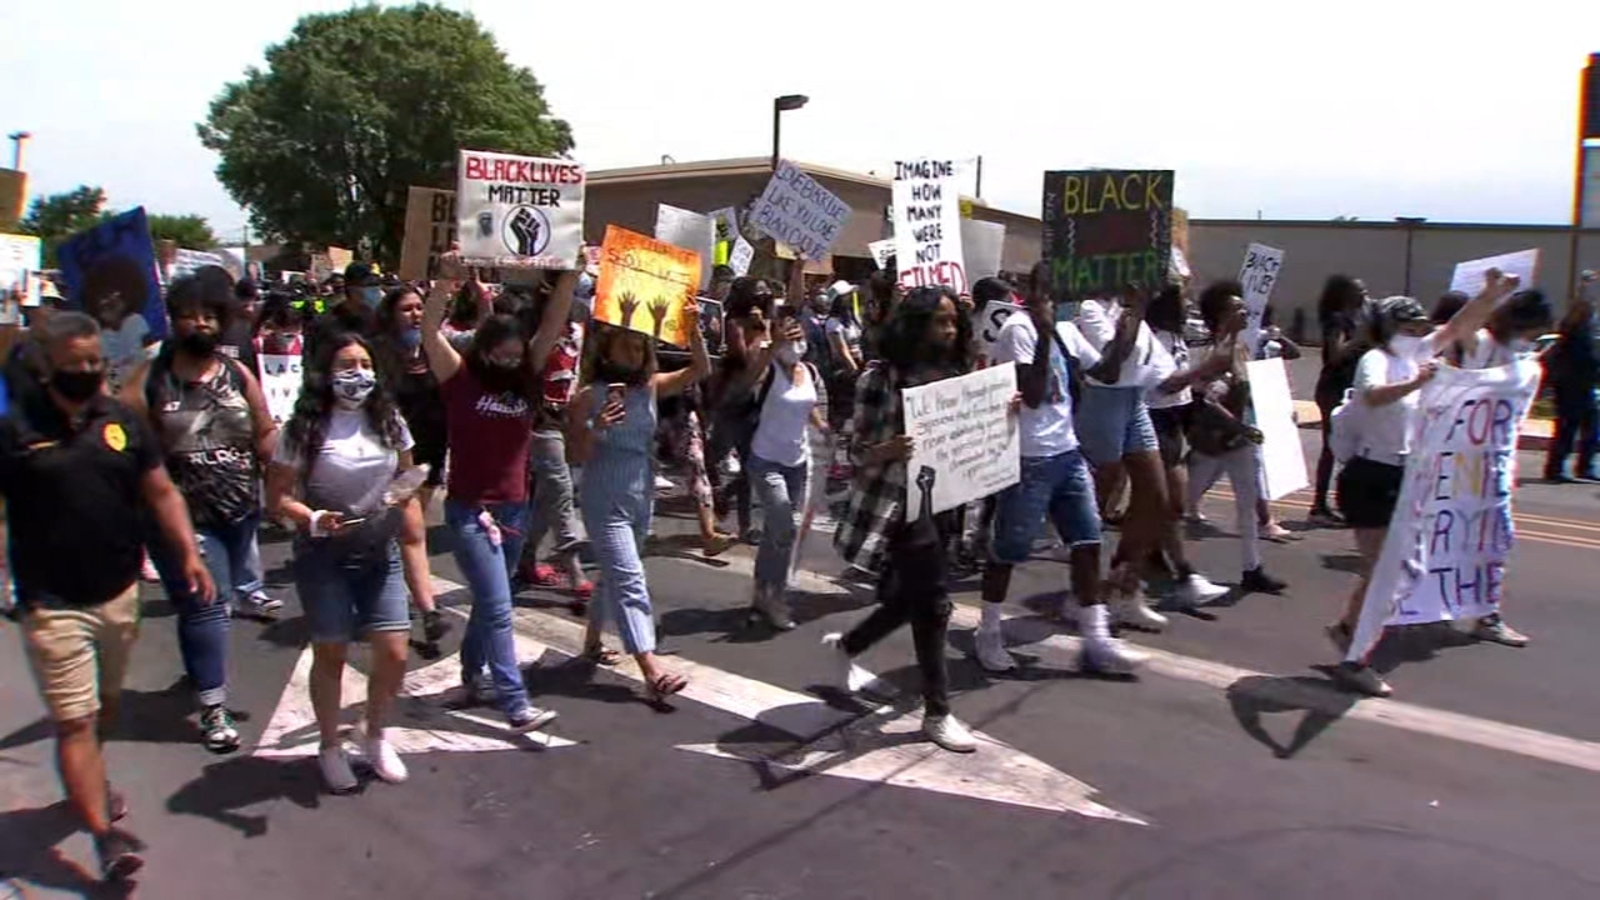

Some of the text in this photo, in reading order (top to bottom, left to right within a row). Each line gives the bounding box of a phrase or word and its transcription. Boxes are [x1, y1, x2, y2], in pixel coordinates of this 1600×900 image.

[893, 160, 954, 181] IMAGINE
[488, 184, 561, 208] MATTER
[911, 183, 942, 201] HOW
[1063, 173, 1164, 215] BLACK
[906, 204, 942, 222] MANY
[913, 223, 943, 242] WERE
[915, 243, 942, 264] NOT
[1051, 250, 1160, 291] MATTER
[1446, 398, 1513, 446] FOR
[1429, 562, 1505, 613] THE
